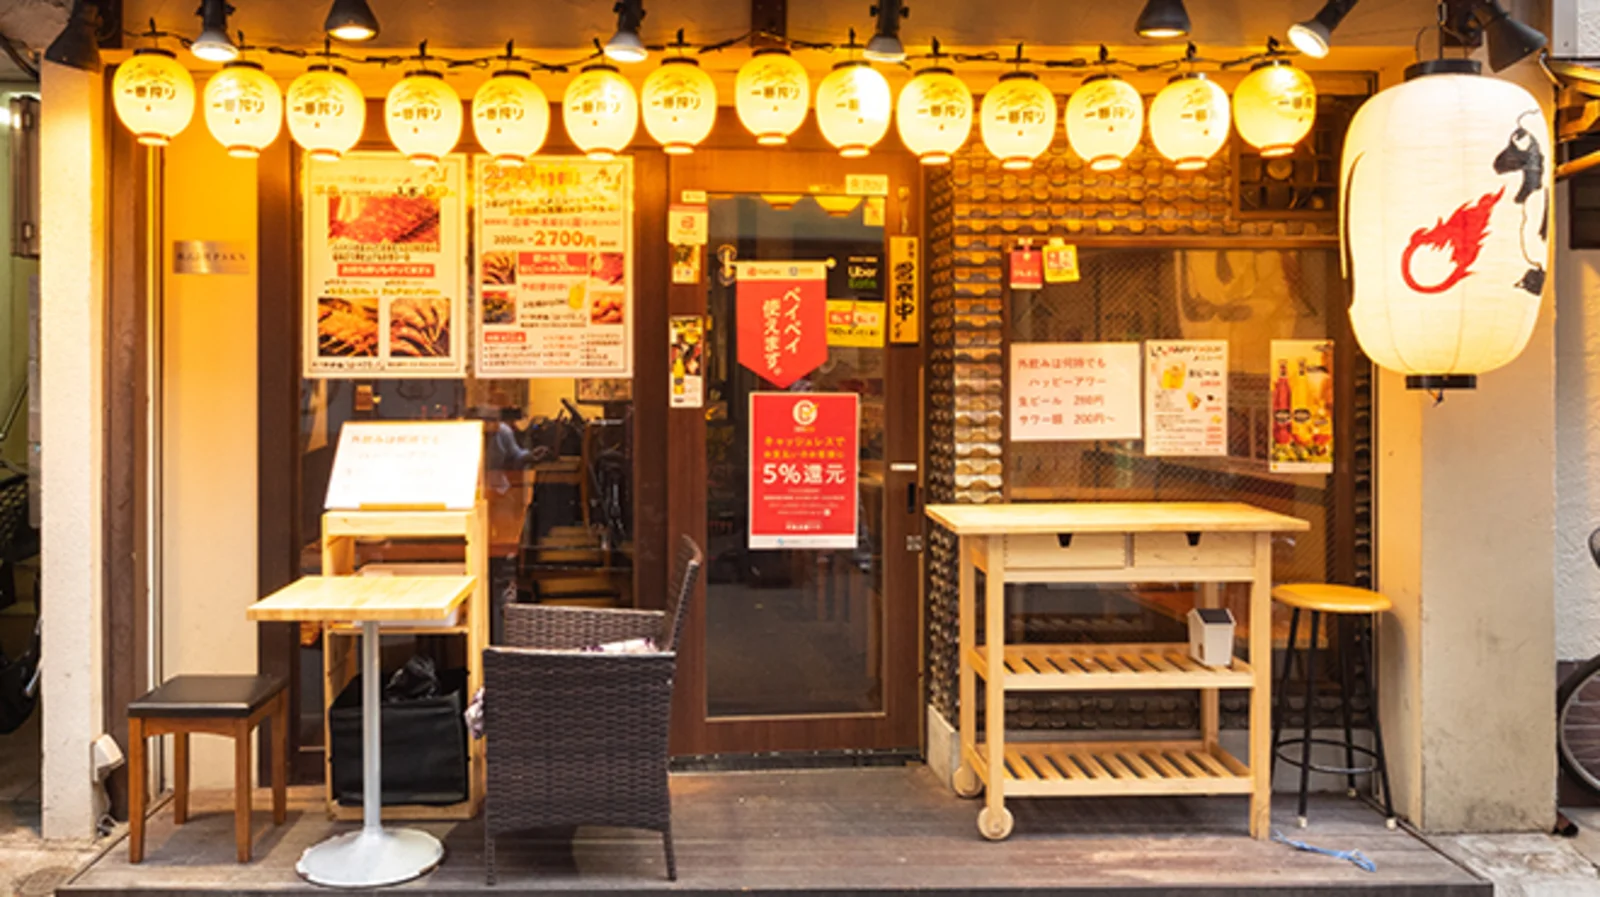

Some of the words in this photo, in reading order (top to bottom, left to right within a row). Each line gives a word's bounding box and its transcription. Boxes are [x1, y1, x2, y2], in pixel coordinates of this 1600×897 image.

[124, 85, 176, 100] 一番搾り
[751, 86, 800, 99] 一番搾り
[213, 98, 265, 113] 一番搾り
[294, 101, 345, 116] 一番搾り
[571, 100, 621, 114] 一番搾り
[652, 96, 700, 110] 一番搾り
[392, 106, 441, 121] 一番搾り
[477, 106, 525, 121] 一番搾り
[917, 104, 966, 118] 一番搾り
[995, 110, 1046, 124] 一番搾り
[1084, 106, 1134, 120] 一番搾り
[848, 266, 877, 278] Uber
[783, 286, 802, 354] ペイペイ
[762, 298, 782, 376] 使えます。
[1028, 375, 1107, 388] ハッピーアワー
[1018, 395, 1063, 408] 生ビール
[762, 462, 846, 484] 5%還元
